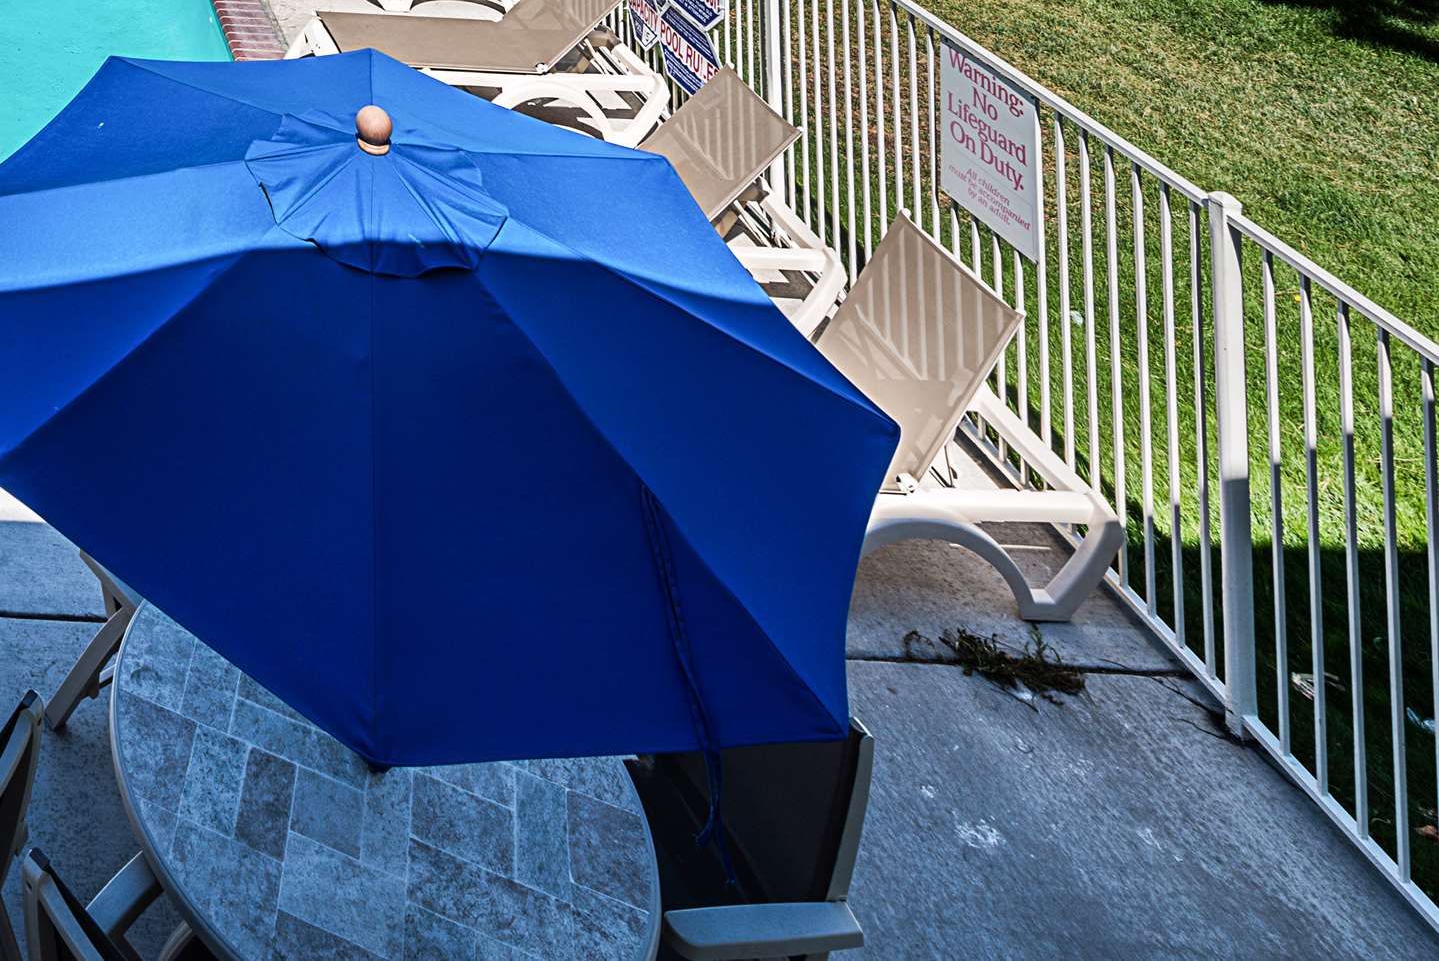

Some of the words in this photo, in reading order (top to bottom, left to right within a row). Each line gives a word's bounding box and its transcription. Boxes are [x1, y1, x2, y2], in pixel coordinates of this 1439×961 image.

[660, 19, 684, 59] POOL
[949, 47, 1024, 118] Warning:
[971, 86, 998, 121] No
[947, 91, 1027, 167] Lifeguard
[950, 120, 976, 155] On
[981, 142, 1024, 191] Duty.
[949, 165, 967, 182] must
[967, 177, 977, 189] be
[978, 188, 1031, 231] accompanied
[966, 168, 978, 180] All
[978, 177, 1010, 205] children
[967, 186, 978, 199] by
[978, 197, 988, 208] an
